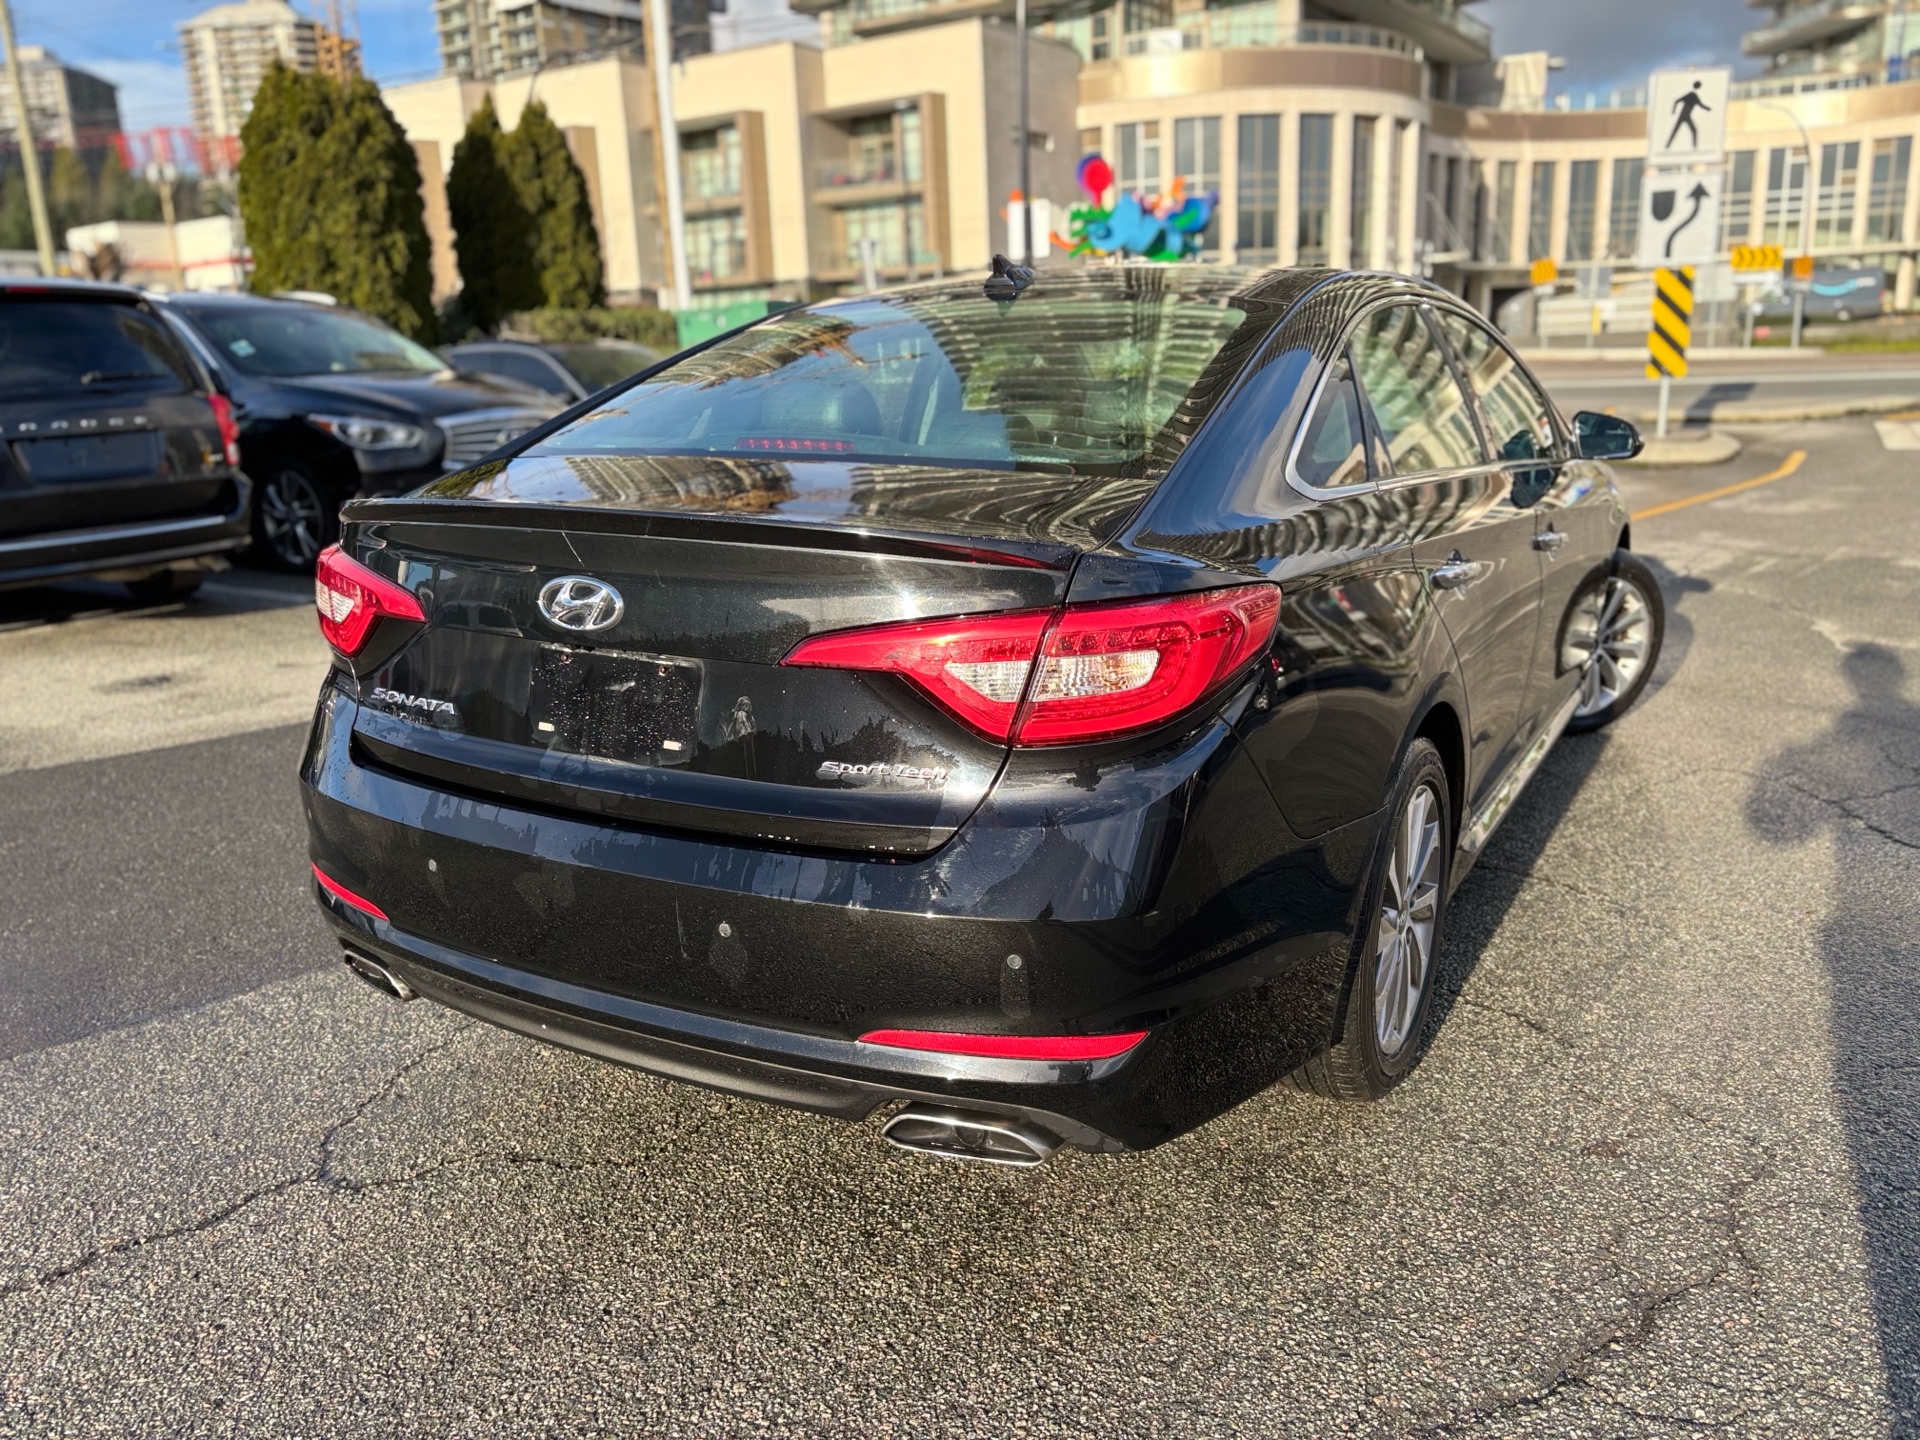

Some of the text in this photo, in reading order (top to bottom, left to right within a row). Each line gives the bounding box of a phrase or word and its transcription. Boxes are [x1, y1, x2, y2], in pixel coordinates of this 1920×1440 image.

[370, 686, 456, 716] SONATA
[819, 761, 948, 780] Sport Tech
